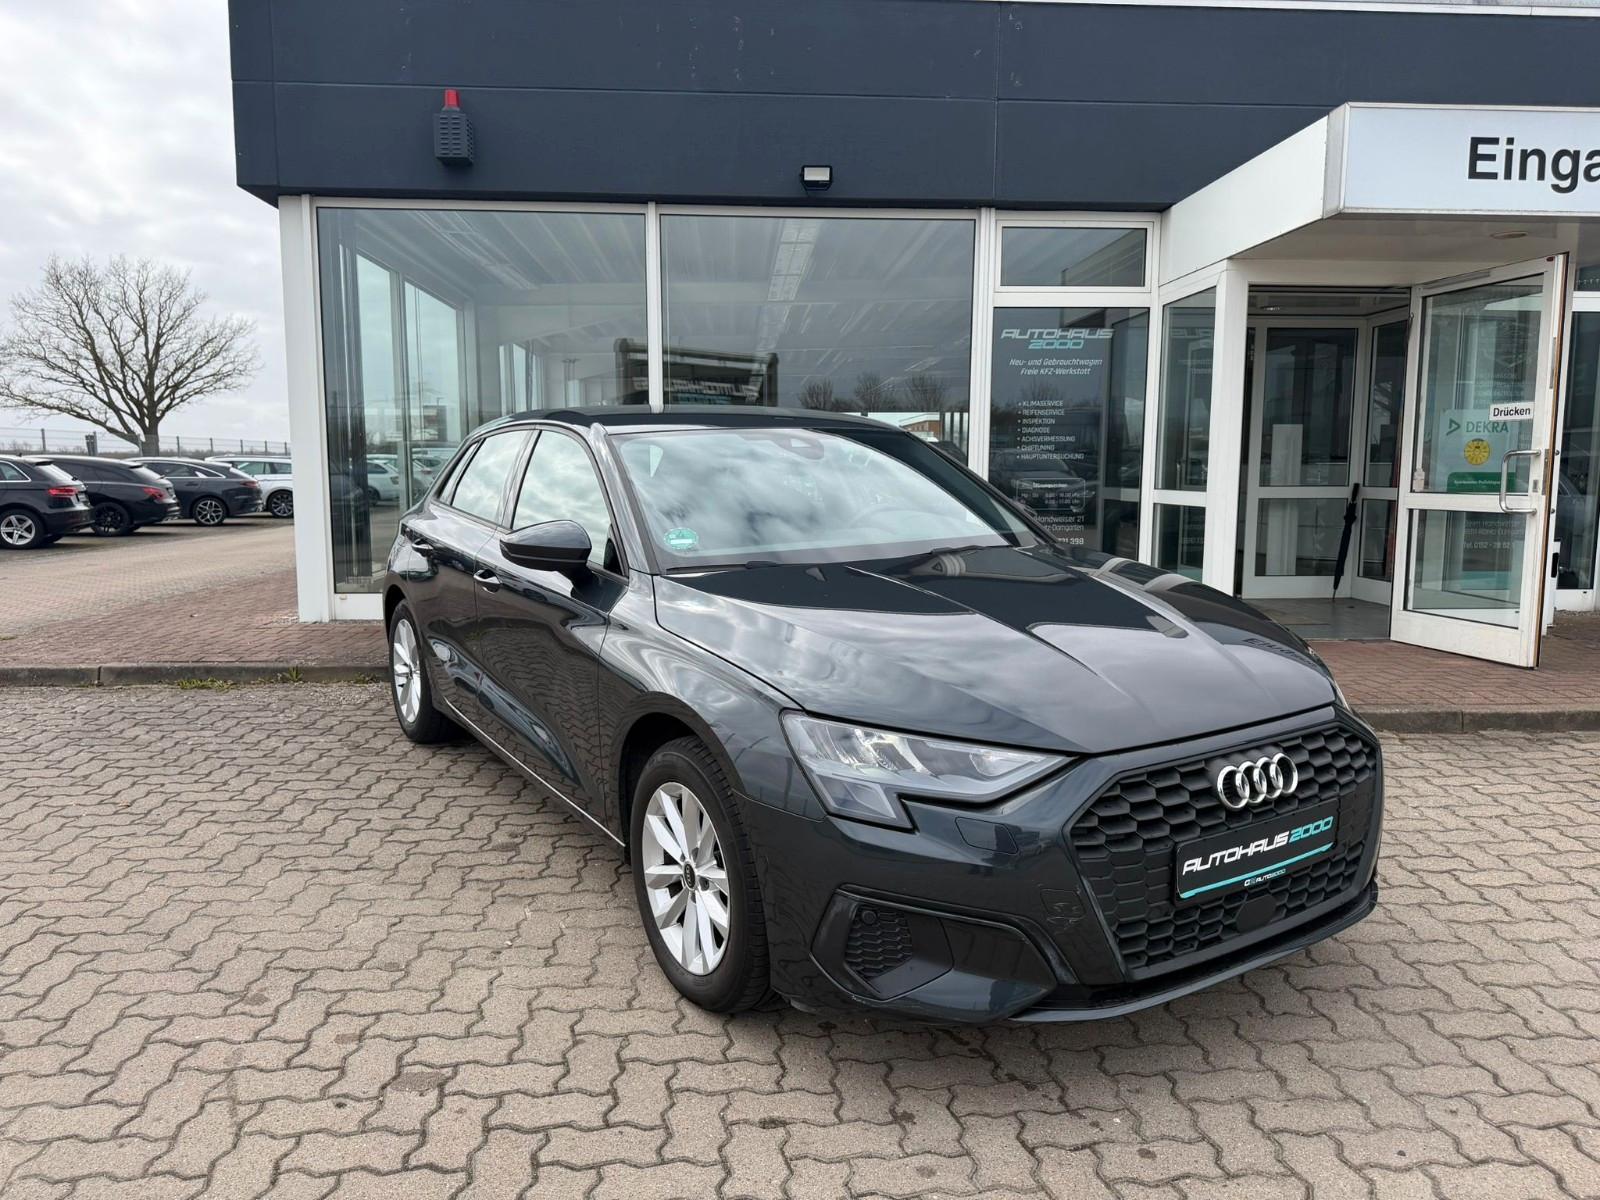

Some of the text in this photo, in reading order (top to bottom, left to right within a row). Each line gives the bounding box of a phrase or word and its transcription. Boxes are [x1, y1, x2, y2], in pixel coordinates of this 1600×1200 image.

[1000, 328, 1114, 339] AUTOHAUS
[1028, 339, 1084, 350] 2000
[1009, 358, 1102, 367] Neu- und Gebrauchtwagen
[1492, 407, 1531, 417] Drücken
[1466, 421, 1509, 433] DEKRA
[1182, 815, 1334, 876] AUTOHAUS 2000
